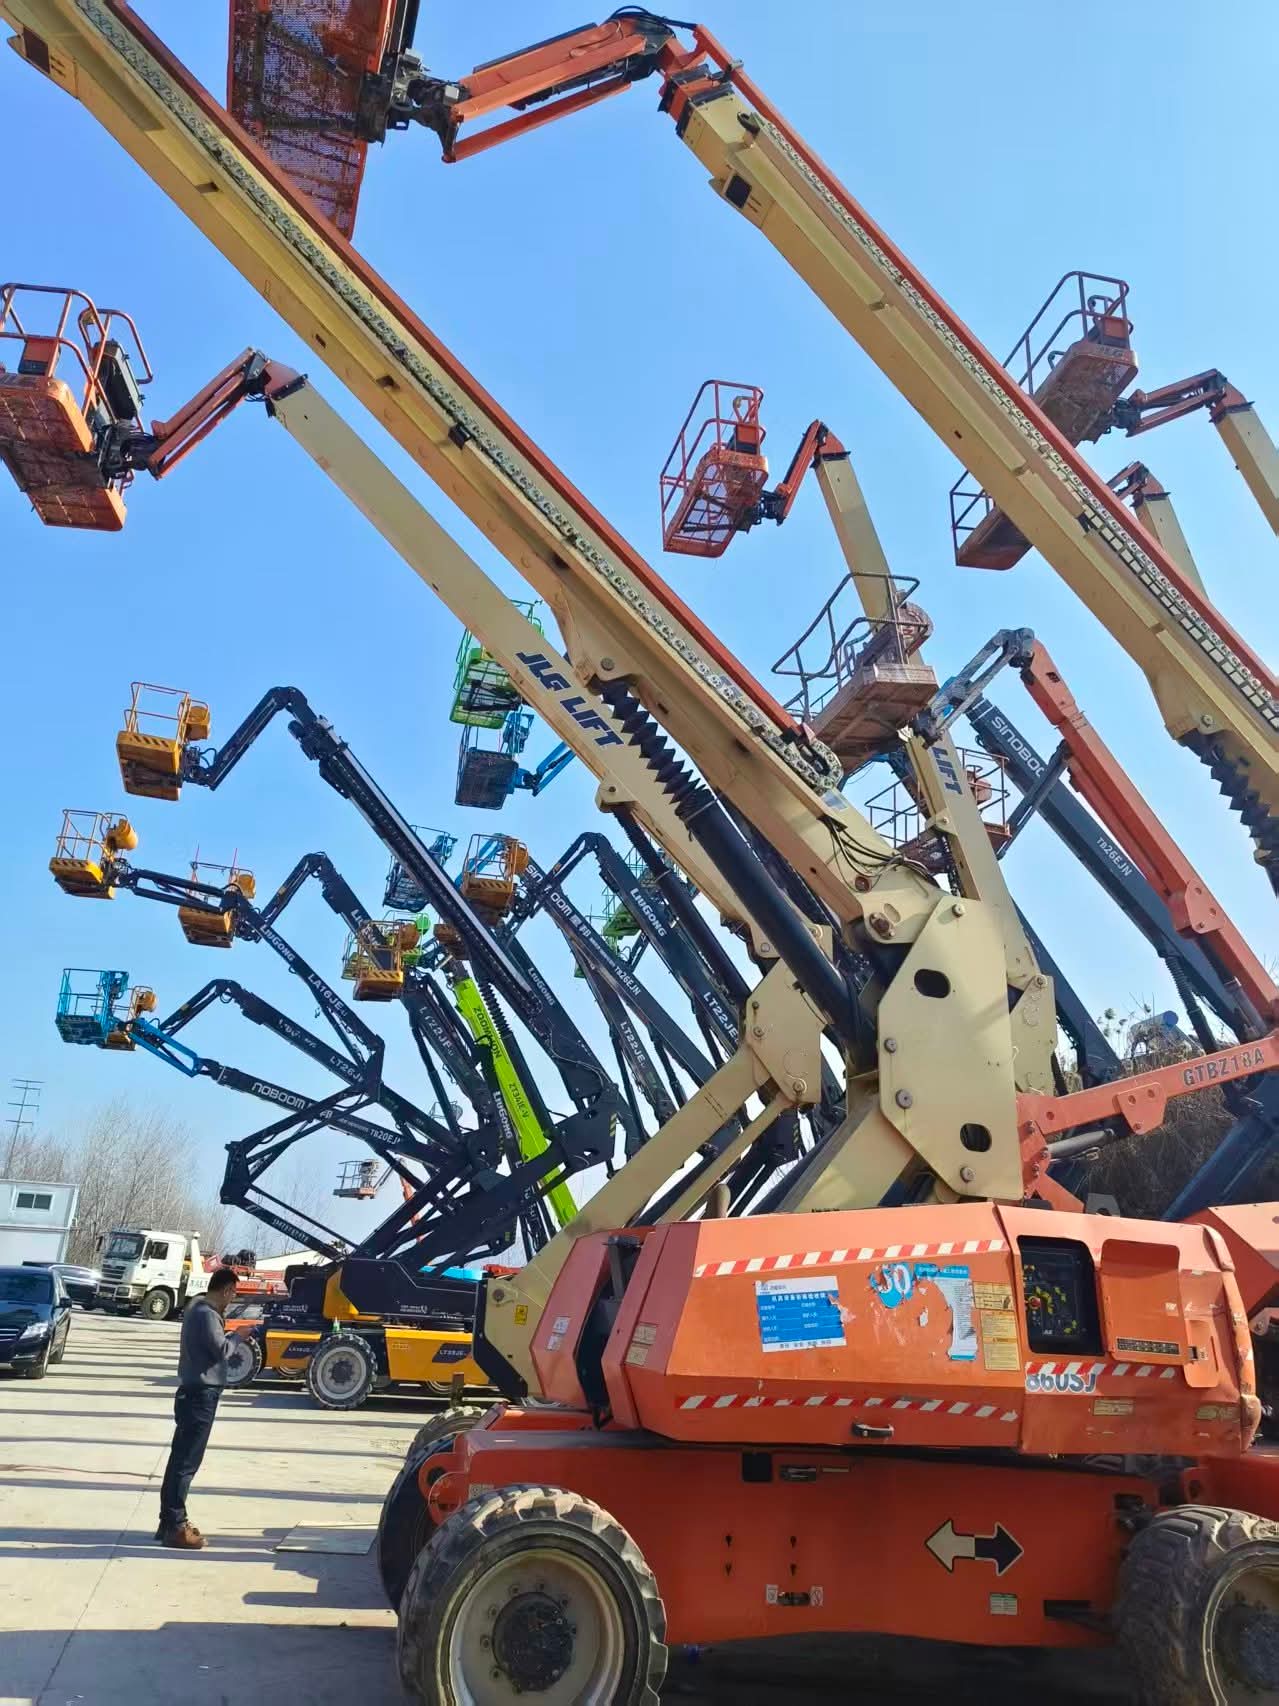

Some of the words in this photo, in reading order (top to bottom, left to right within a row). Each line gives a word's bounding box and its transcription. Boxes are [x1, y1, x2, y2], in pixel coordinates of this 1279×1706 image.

[515, 651, 572, 691] JLG
[560, 696, 625, 746] LIFT
[931, 747, 963, 795] LIFT
[991, 716, 1045, 778] SINOBO
[630, 888, 667, 937] LIUGONG
